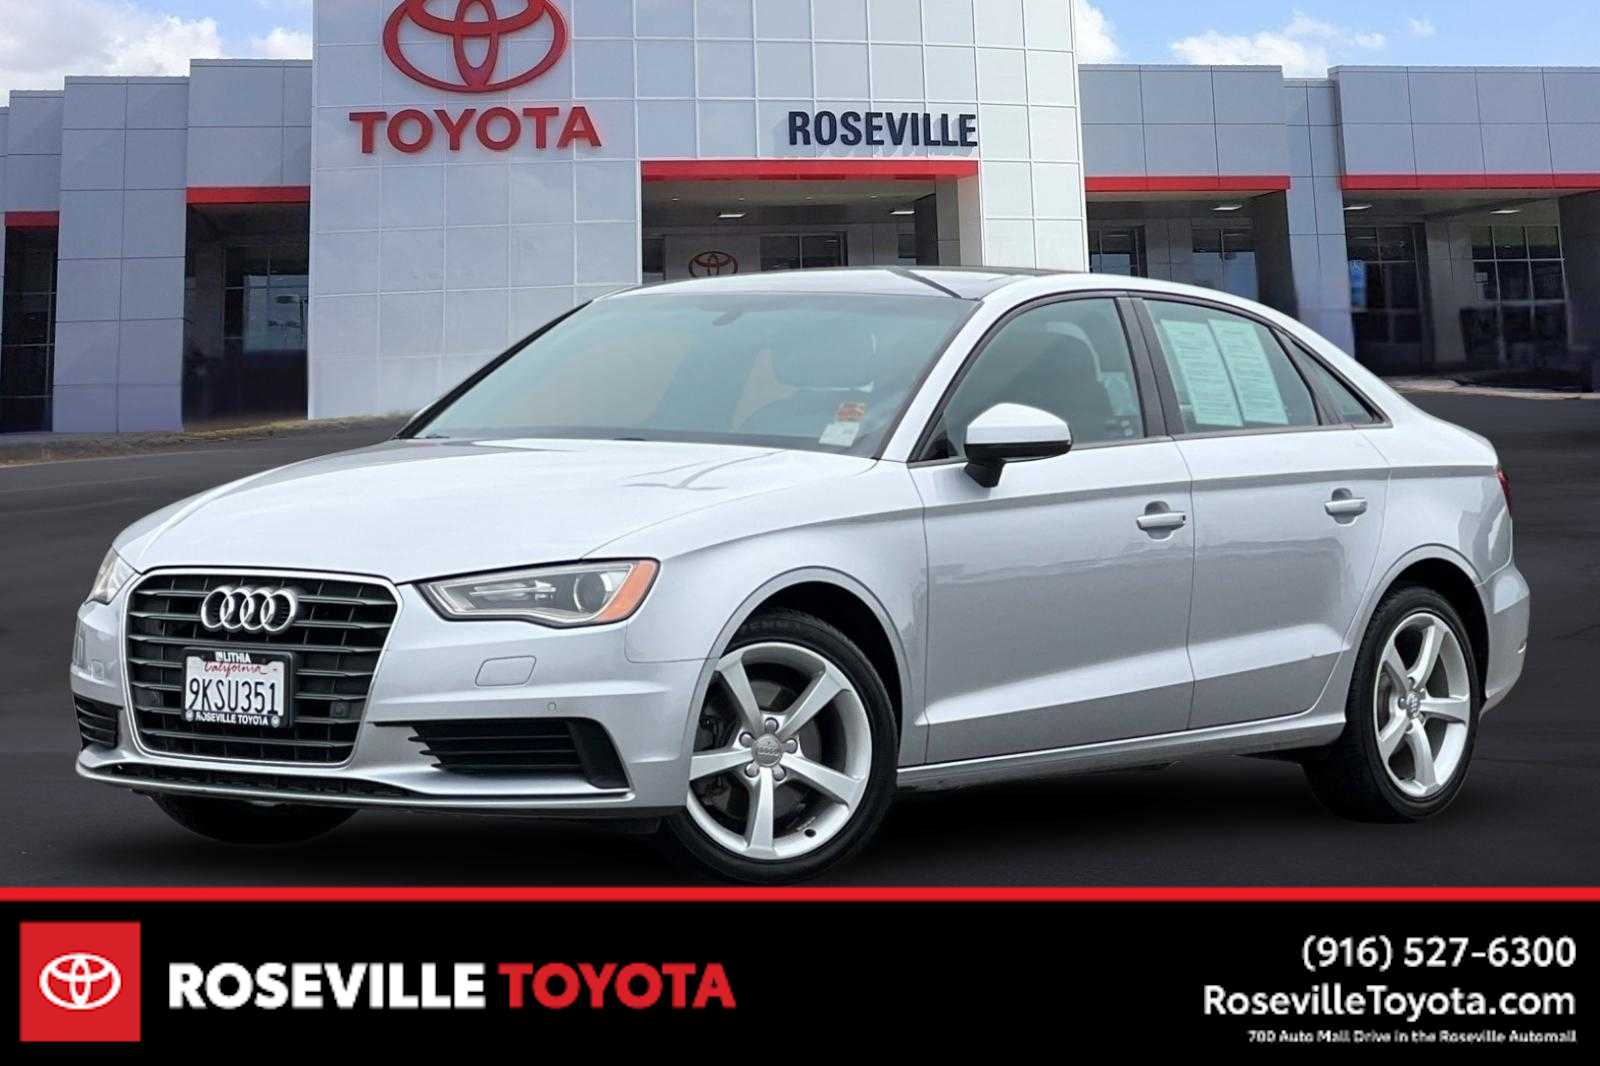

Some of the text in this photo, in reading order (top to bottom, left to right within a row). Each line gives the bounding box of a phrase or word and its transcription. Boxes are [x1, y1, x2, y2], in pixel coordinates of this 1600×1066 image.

[349, 106, 602, 154] TOYOTA
[788, 110, 978, 147] ROSEVILLE
[204, 661, 261, 678] California
[223, 651, 251, 663] LITHIA
[189, 678, 279, 715] 9KSU351
[196, 711, 269, 726] ROSEVILLE TOYOTA
